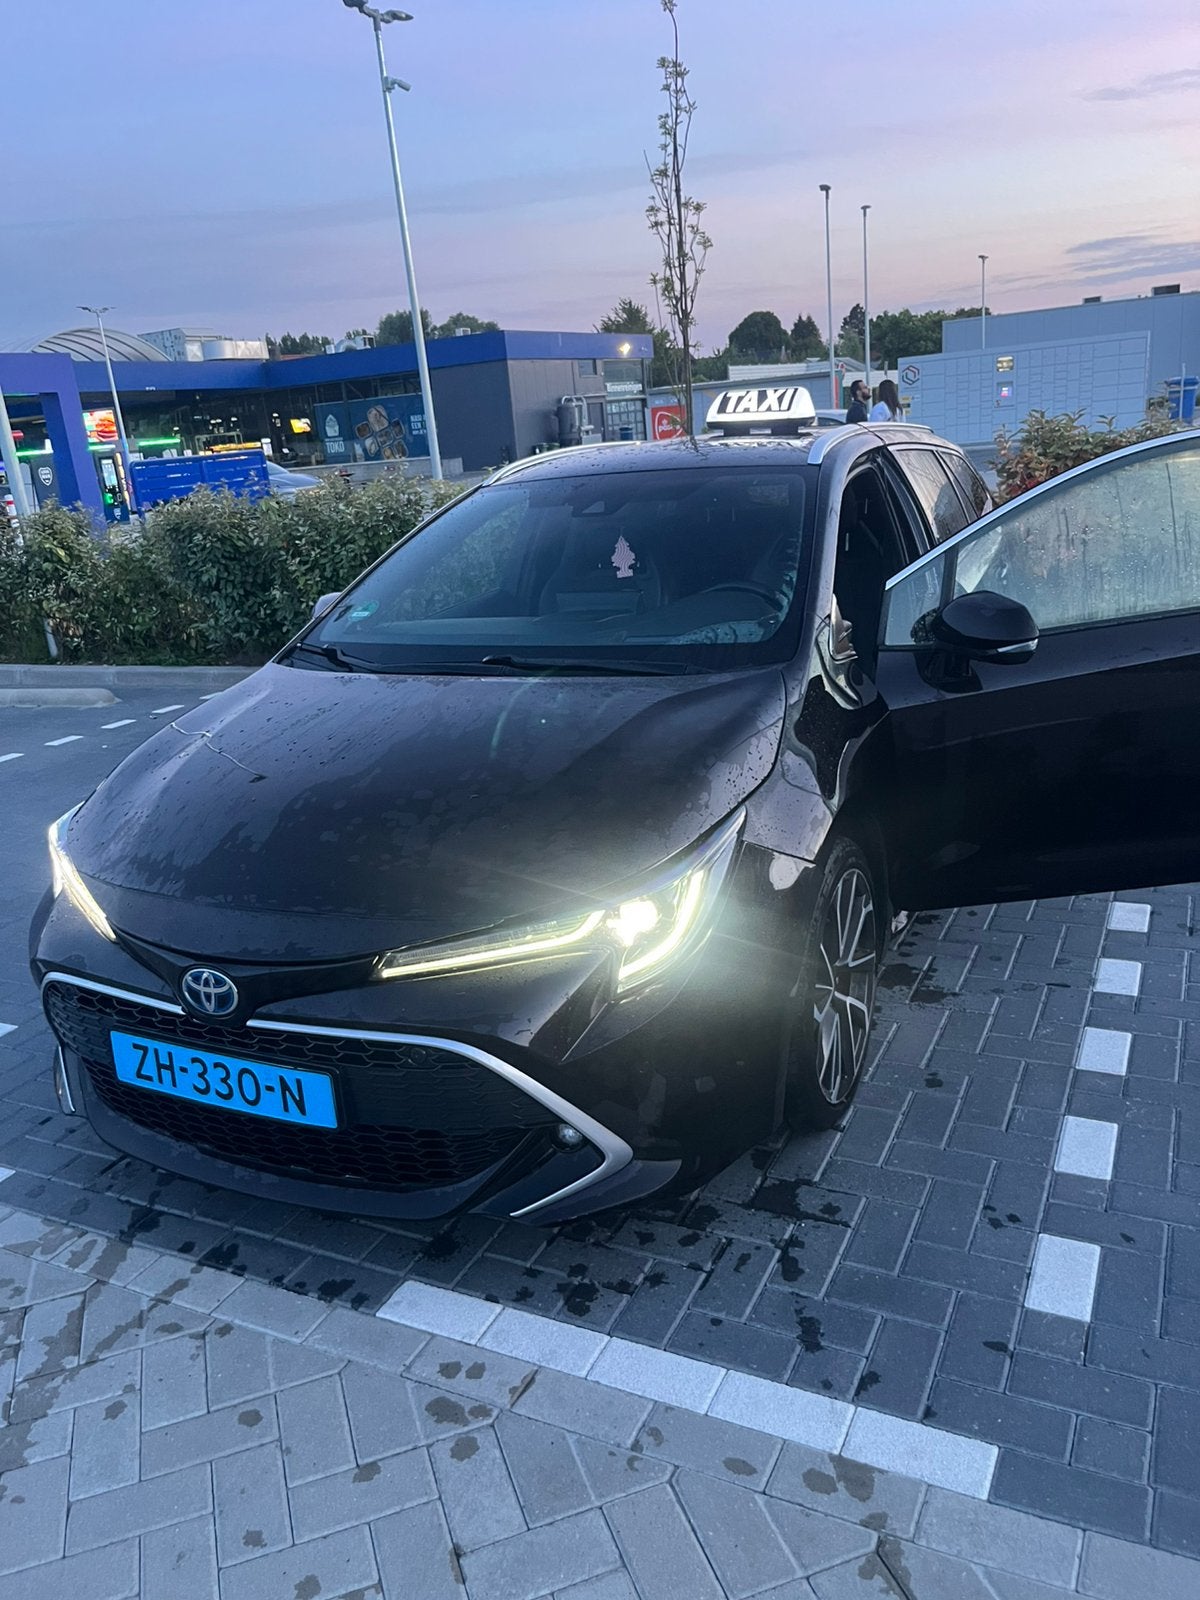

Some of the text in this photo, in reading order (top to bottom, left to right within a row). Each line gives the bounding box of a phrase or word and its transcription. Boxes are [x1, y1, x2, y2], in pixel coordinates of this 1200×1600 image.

[725, 388, 796, 414] TAXI
[326, 441, 344, 453] TOKO
[132, 1042, 307, 1117] ZH-330-N
